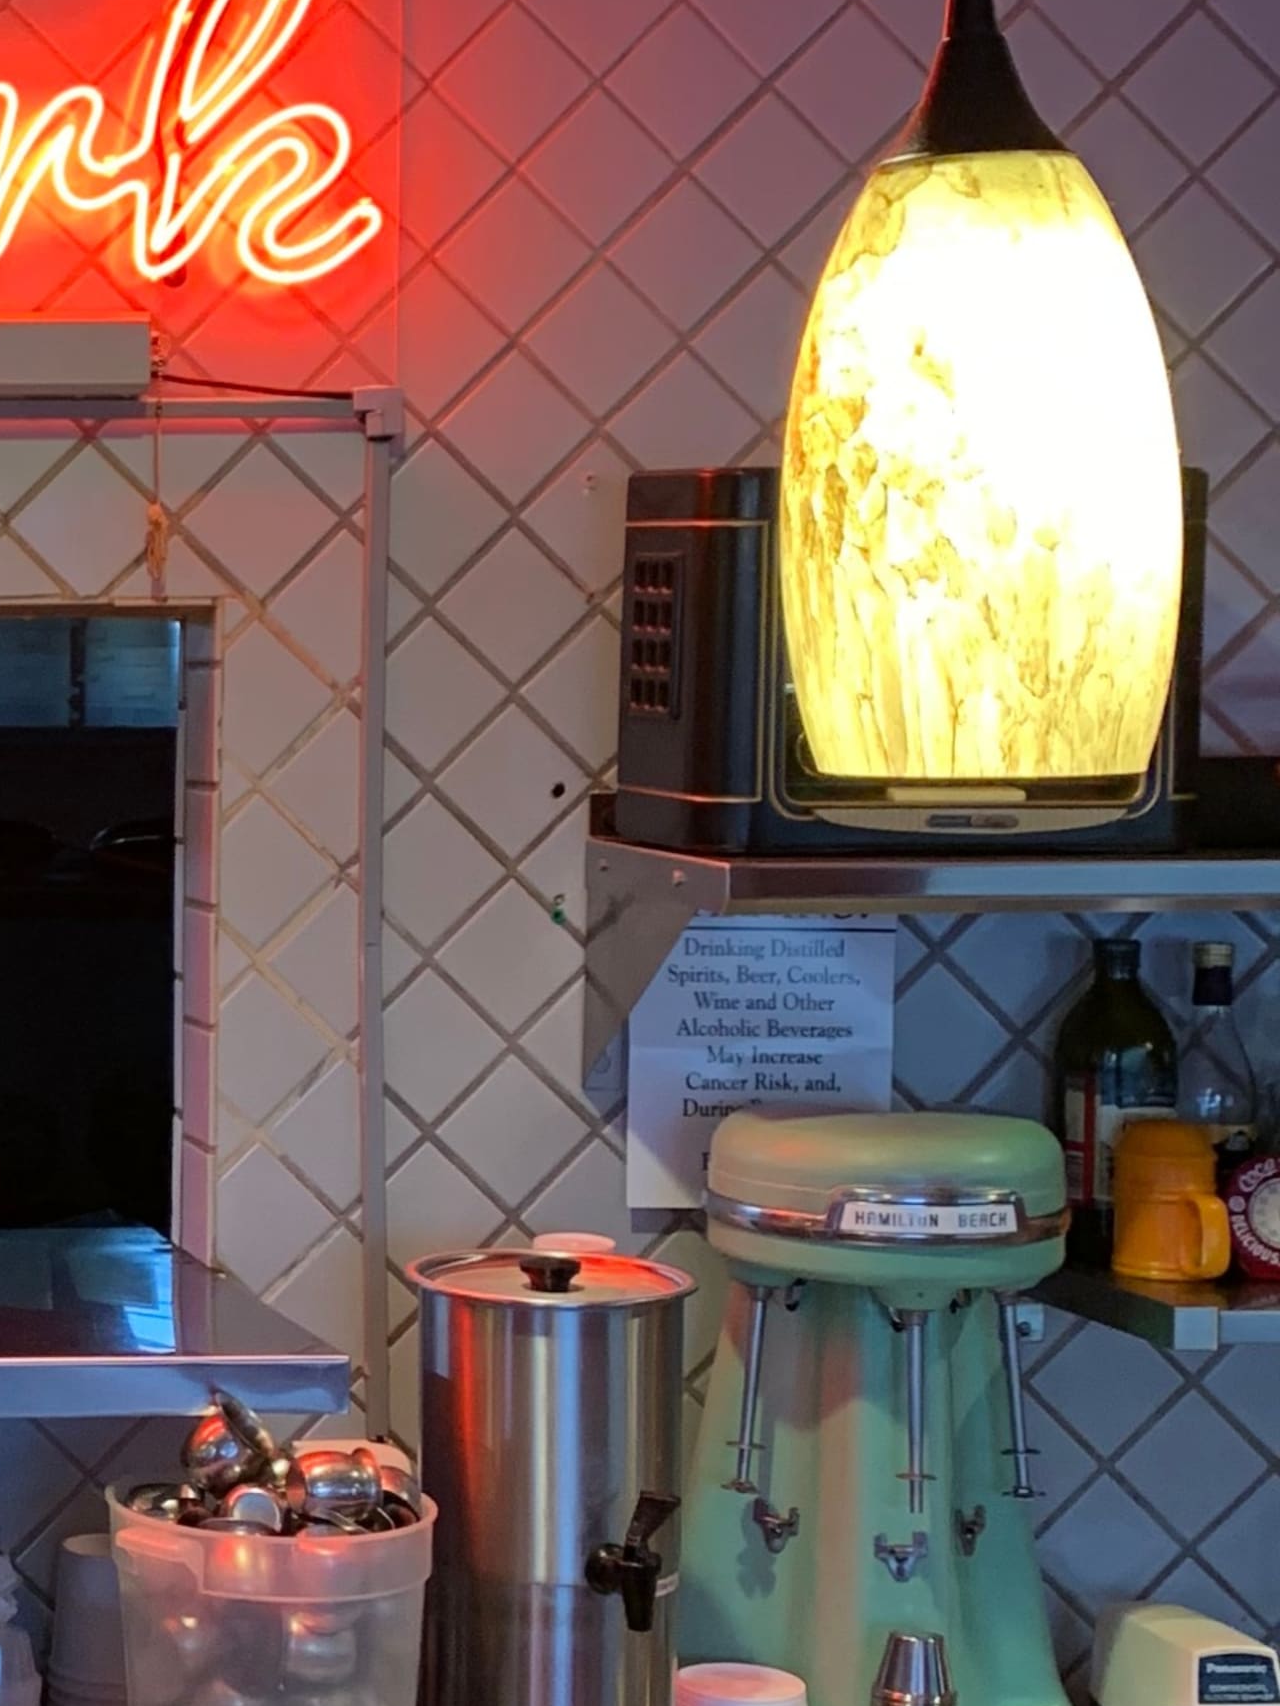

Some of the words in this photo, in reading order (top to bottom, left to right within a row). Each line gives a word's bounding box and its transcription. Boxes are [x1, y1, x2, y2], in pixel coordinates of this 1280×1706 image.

[684, 936, 765, 961] Drinking
[771, 938, 845, 959] Distilled
[667, 964, 731, 986] Spirits,
[736, 965, 782, 986] Beer,
[787, 966, 861, 986] Coolers,
[693, 991, 740, 1012] Wine
[745, 992, 777, 1011] and
[783, 992, 836, 1012] Other
[676, 1018, 761, 1038] Alcoholic
[766, 1019, 854, 1040] Beverages
[706, 1045, 743, 1068] May
[751, 1046, 823, 1065] Increase
[685, 1071, 749, 1092] Cancer
[754, 1072, 800, 1093] Risk,
[804, 1072, 842, 1093] and,
[854, 1210, 939, 1229] HAMILTON
[957, 1211, 1009, 1229] BEACH
